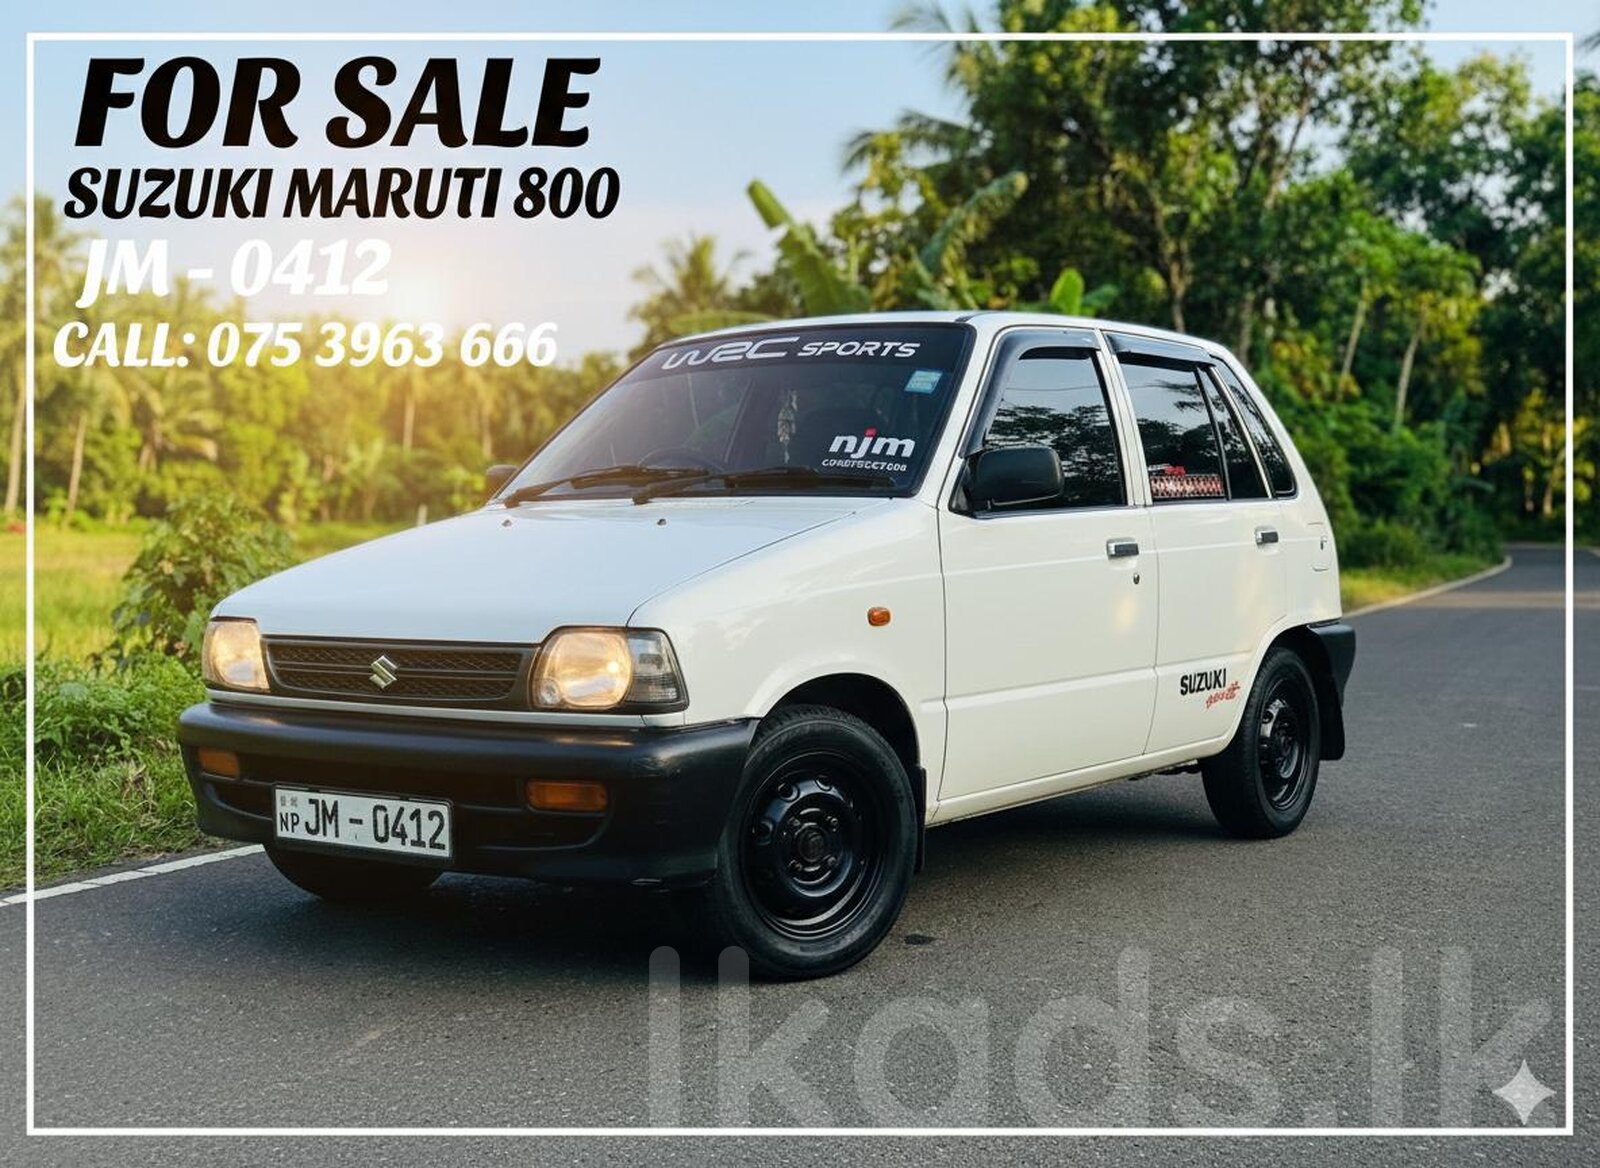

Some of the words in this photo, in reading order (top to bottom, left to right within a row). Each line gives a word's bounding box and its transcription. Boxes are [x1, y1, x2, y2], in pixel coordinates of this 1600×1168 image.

[798, 341, 921, 358] SPORTS
[828, 426, 916, 459] njm
[1180, 668, 1226, 696] SUZUKI
[279, 812, 300, 833] NP
[304, 798, 340, 838] JM
[372, 804, 446, 850] 0412
